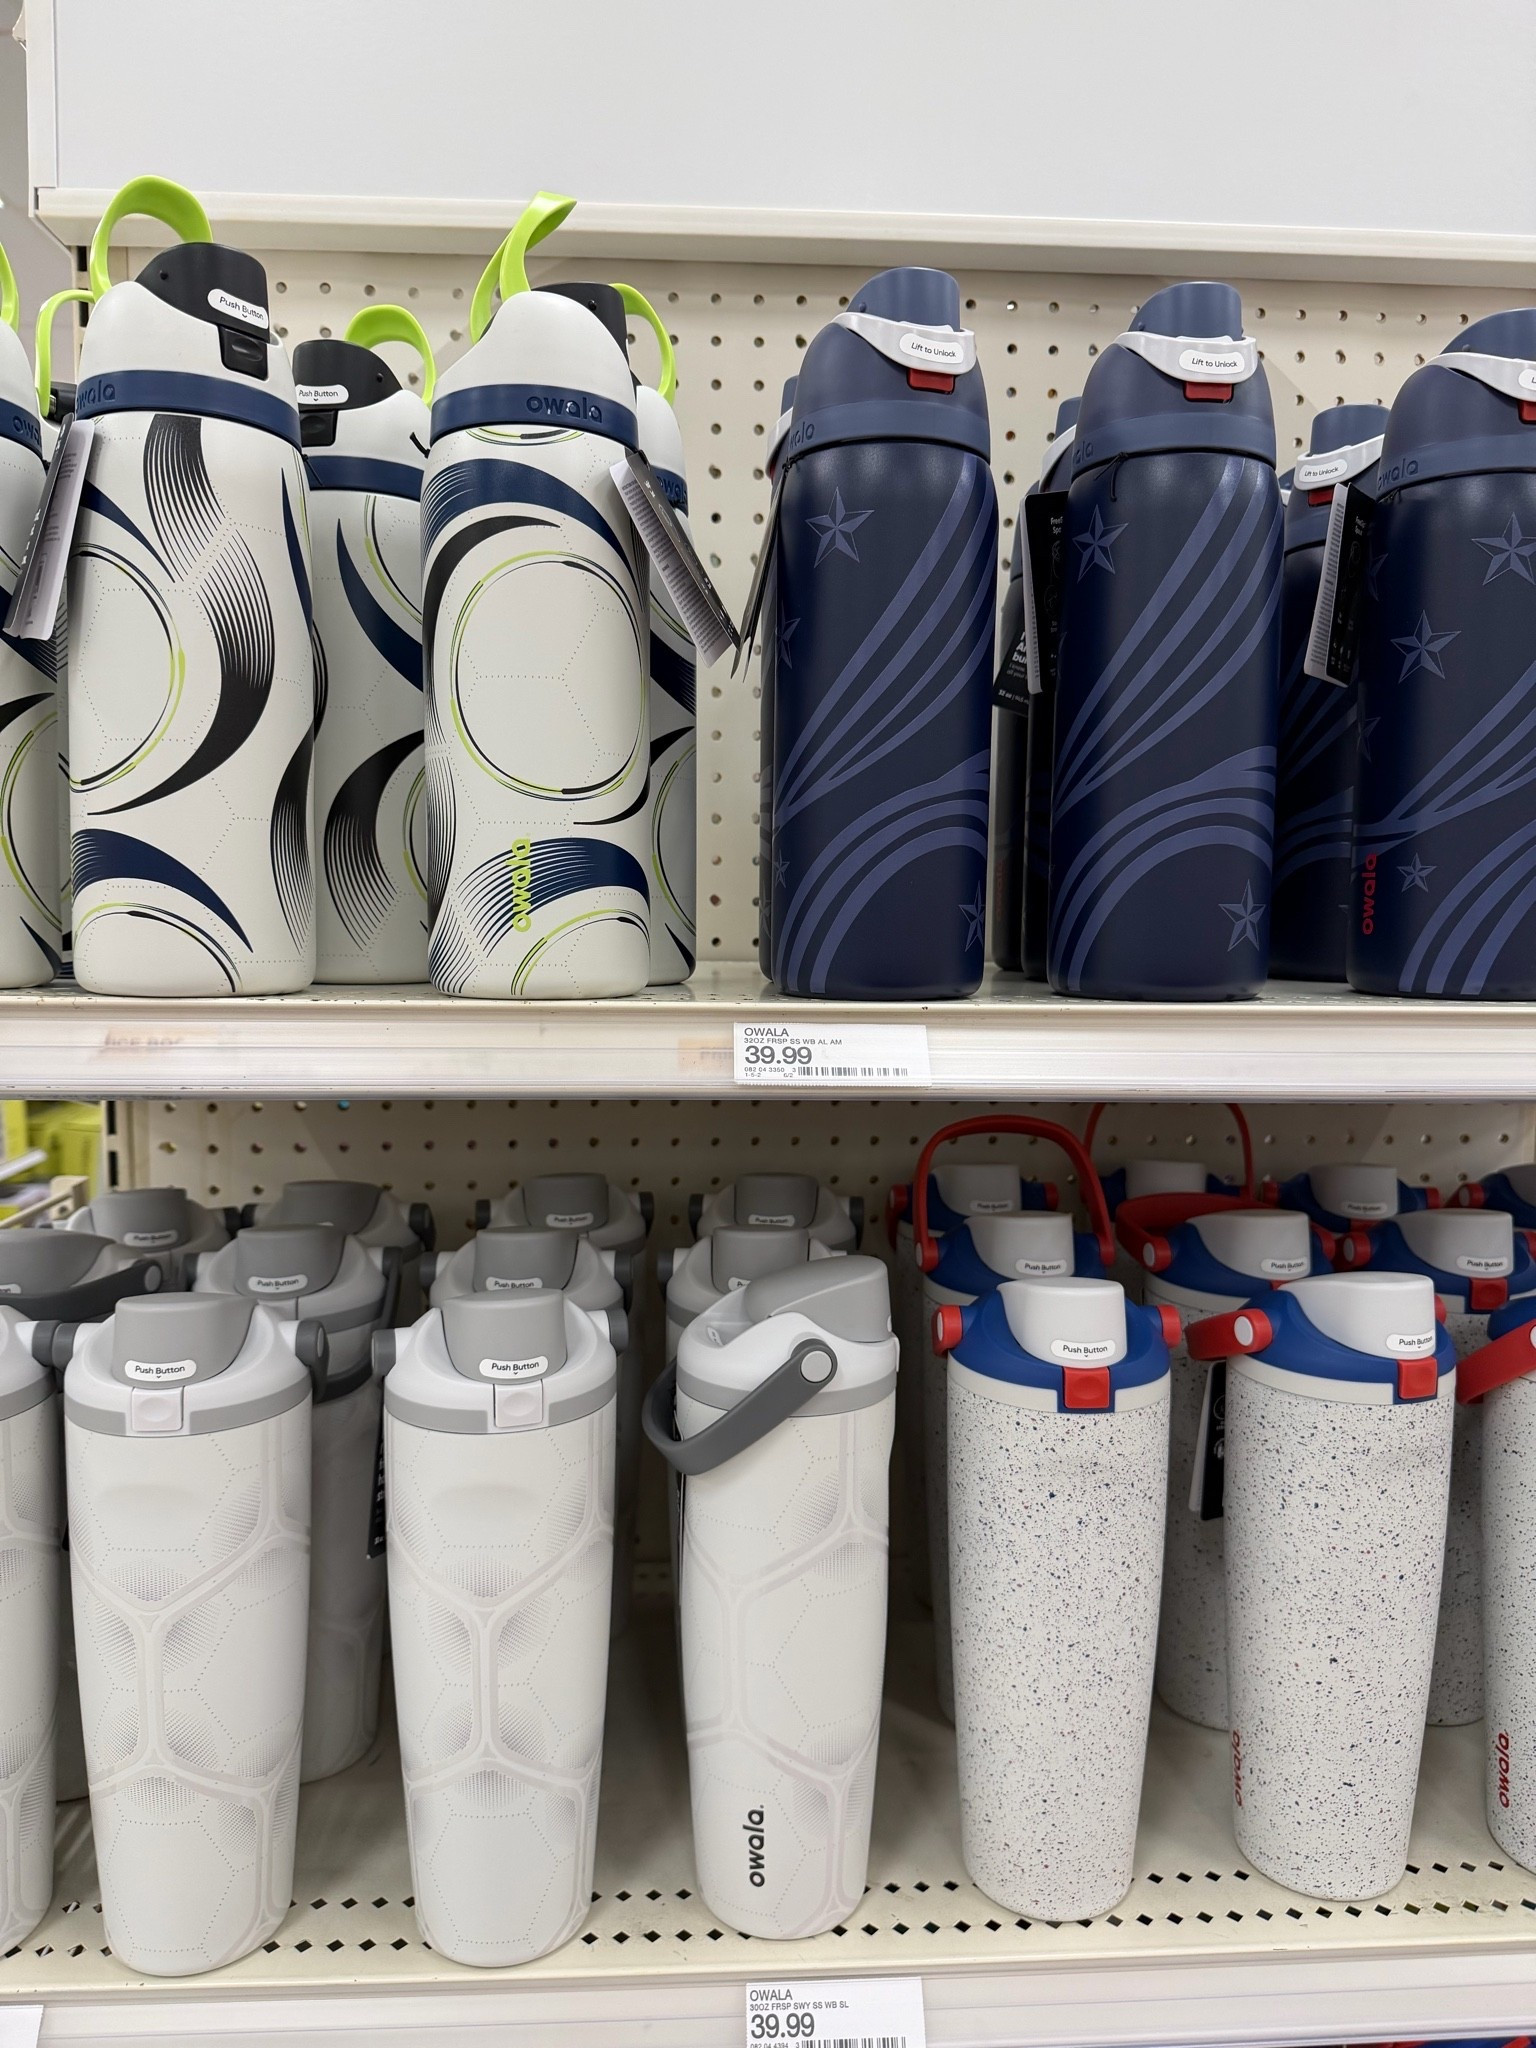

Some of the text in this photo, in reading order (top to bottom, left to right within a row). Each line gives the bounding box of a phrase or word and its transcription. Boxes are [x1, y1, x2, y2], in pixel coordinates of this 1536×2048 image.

[219, 296, 264, 320] Push Button
[911, 342, 956, 357] Lift to Unlock
[1191, 357, 1204, 366] Lift
[1214, 360, 1238, 368] Unlock
[526, 396, 603, 423] owala
[1319, 466, 1339, 476] Unlock
[506, 838, 532, 933] owala
[1361, 853, 1377, 935] owala
[744, 1027, 789, 1037] OWALA
[744, 1045, 812, 1064] 39.99
[1024, 1262, 1061, 1271] Push Button
[1466, 1259, 1484, 1267] Push
[257, 1278, 299, 1287] Push Button
[494, 1280, 510, 1288] Push
[1398, 1336, 1432, 1346] Push Button
[1062, 1344, 1108, 1354] Push Button
[135, 1365, 185, 1374] Push Button
[492, 1361, 539, 1371] Push Button
[1232, 1730, 1242, 1807] owala
[1495, 1733, 1510, 1808] owala
[749, 1988, 793, 2001] OWALA
[749, 2003, 769, 2011] 30OZ
[771, 2002, 792, 2010] FRSP
[793, 2001, 811, 2009] SWY
[812, 2001, 823, 2009] SS
[839, 2000, 849, 2008] SL
[750, 2012, 815, 2039] 39.99
